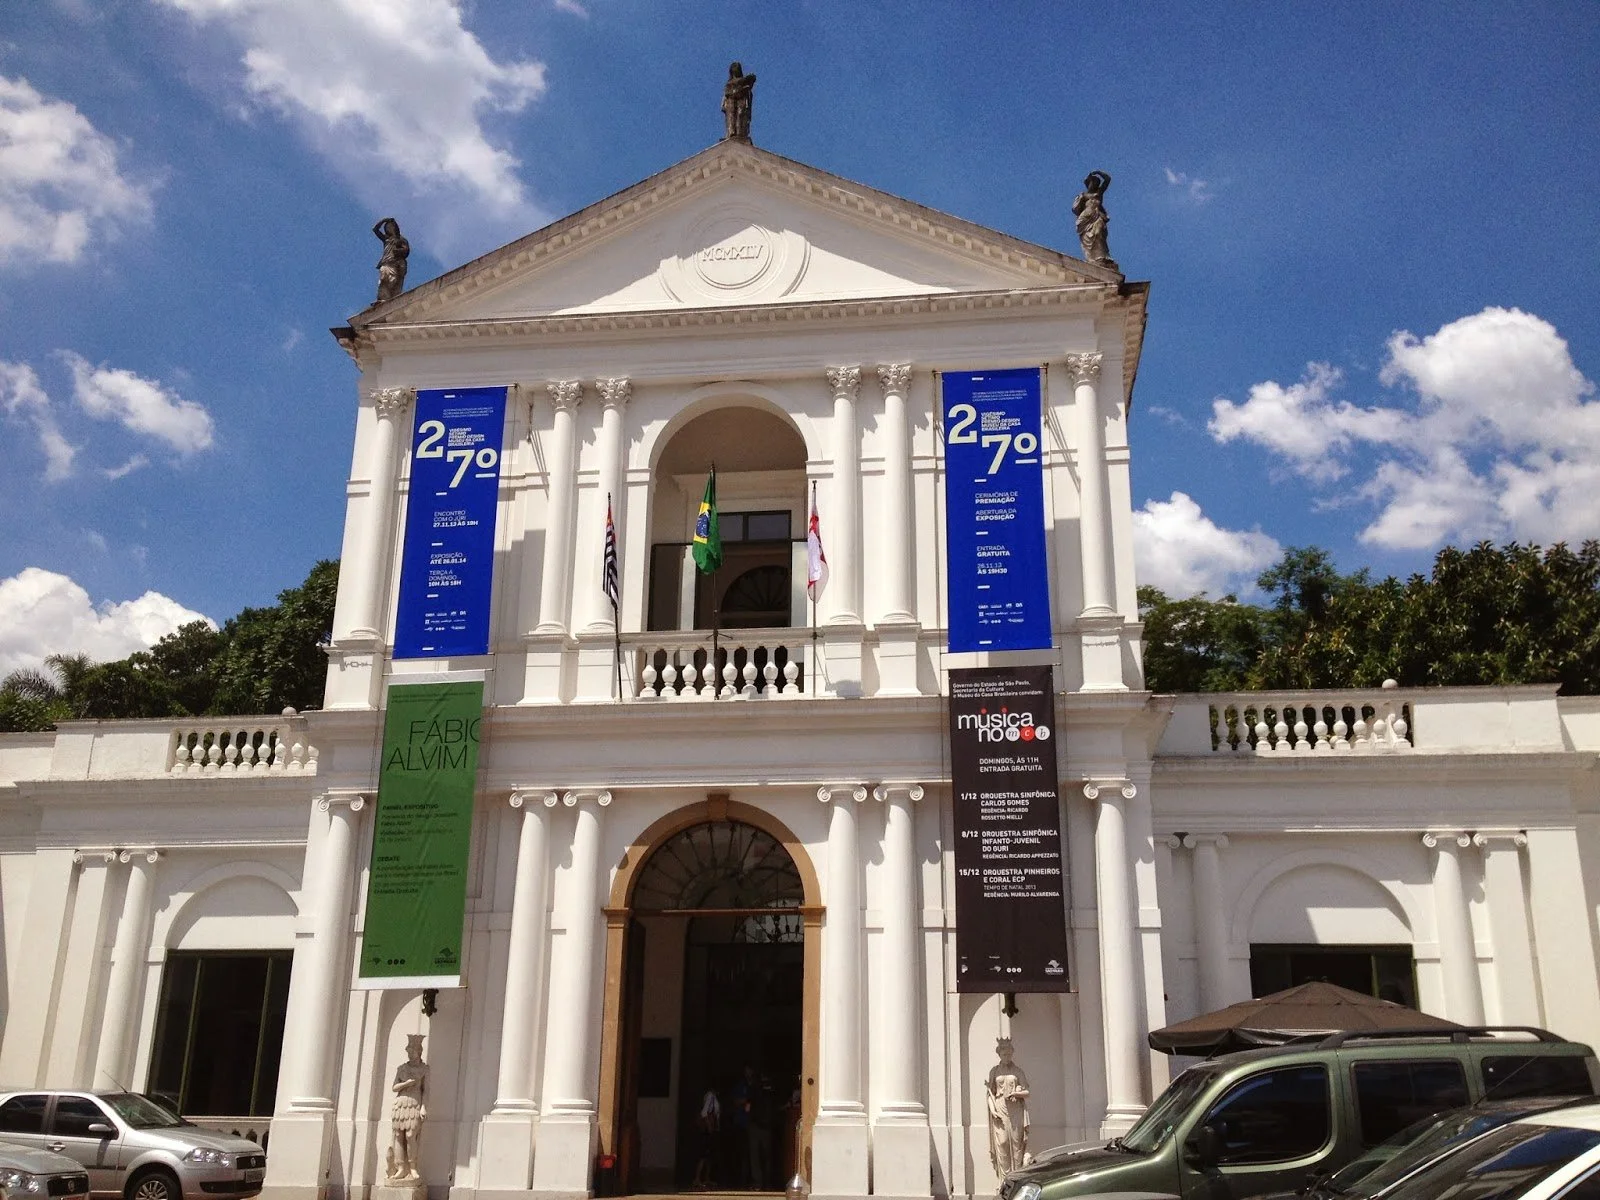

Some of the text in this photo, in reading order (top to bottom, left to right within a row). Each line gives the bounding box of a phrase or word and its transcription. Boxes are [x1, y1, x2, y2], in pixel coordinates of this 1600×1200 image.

[702, 245, 763, 262] MCMXIV
[979, 727, 1004, 742] no
[386, 745, 467, 771] ALVIM
[980, 757, 1015, 765] DOMINGOS,
[1020, 790, 1056, 798] SINFÔNICA
